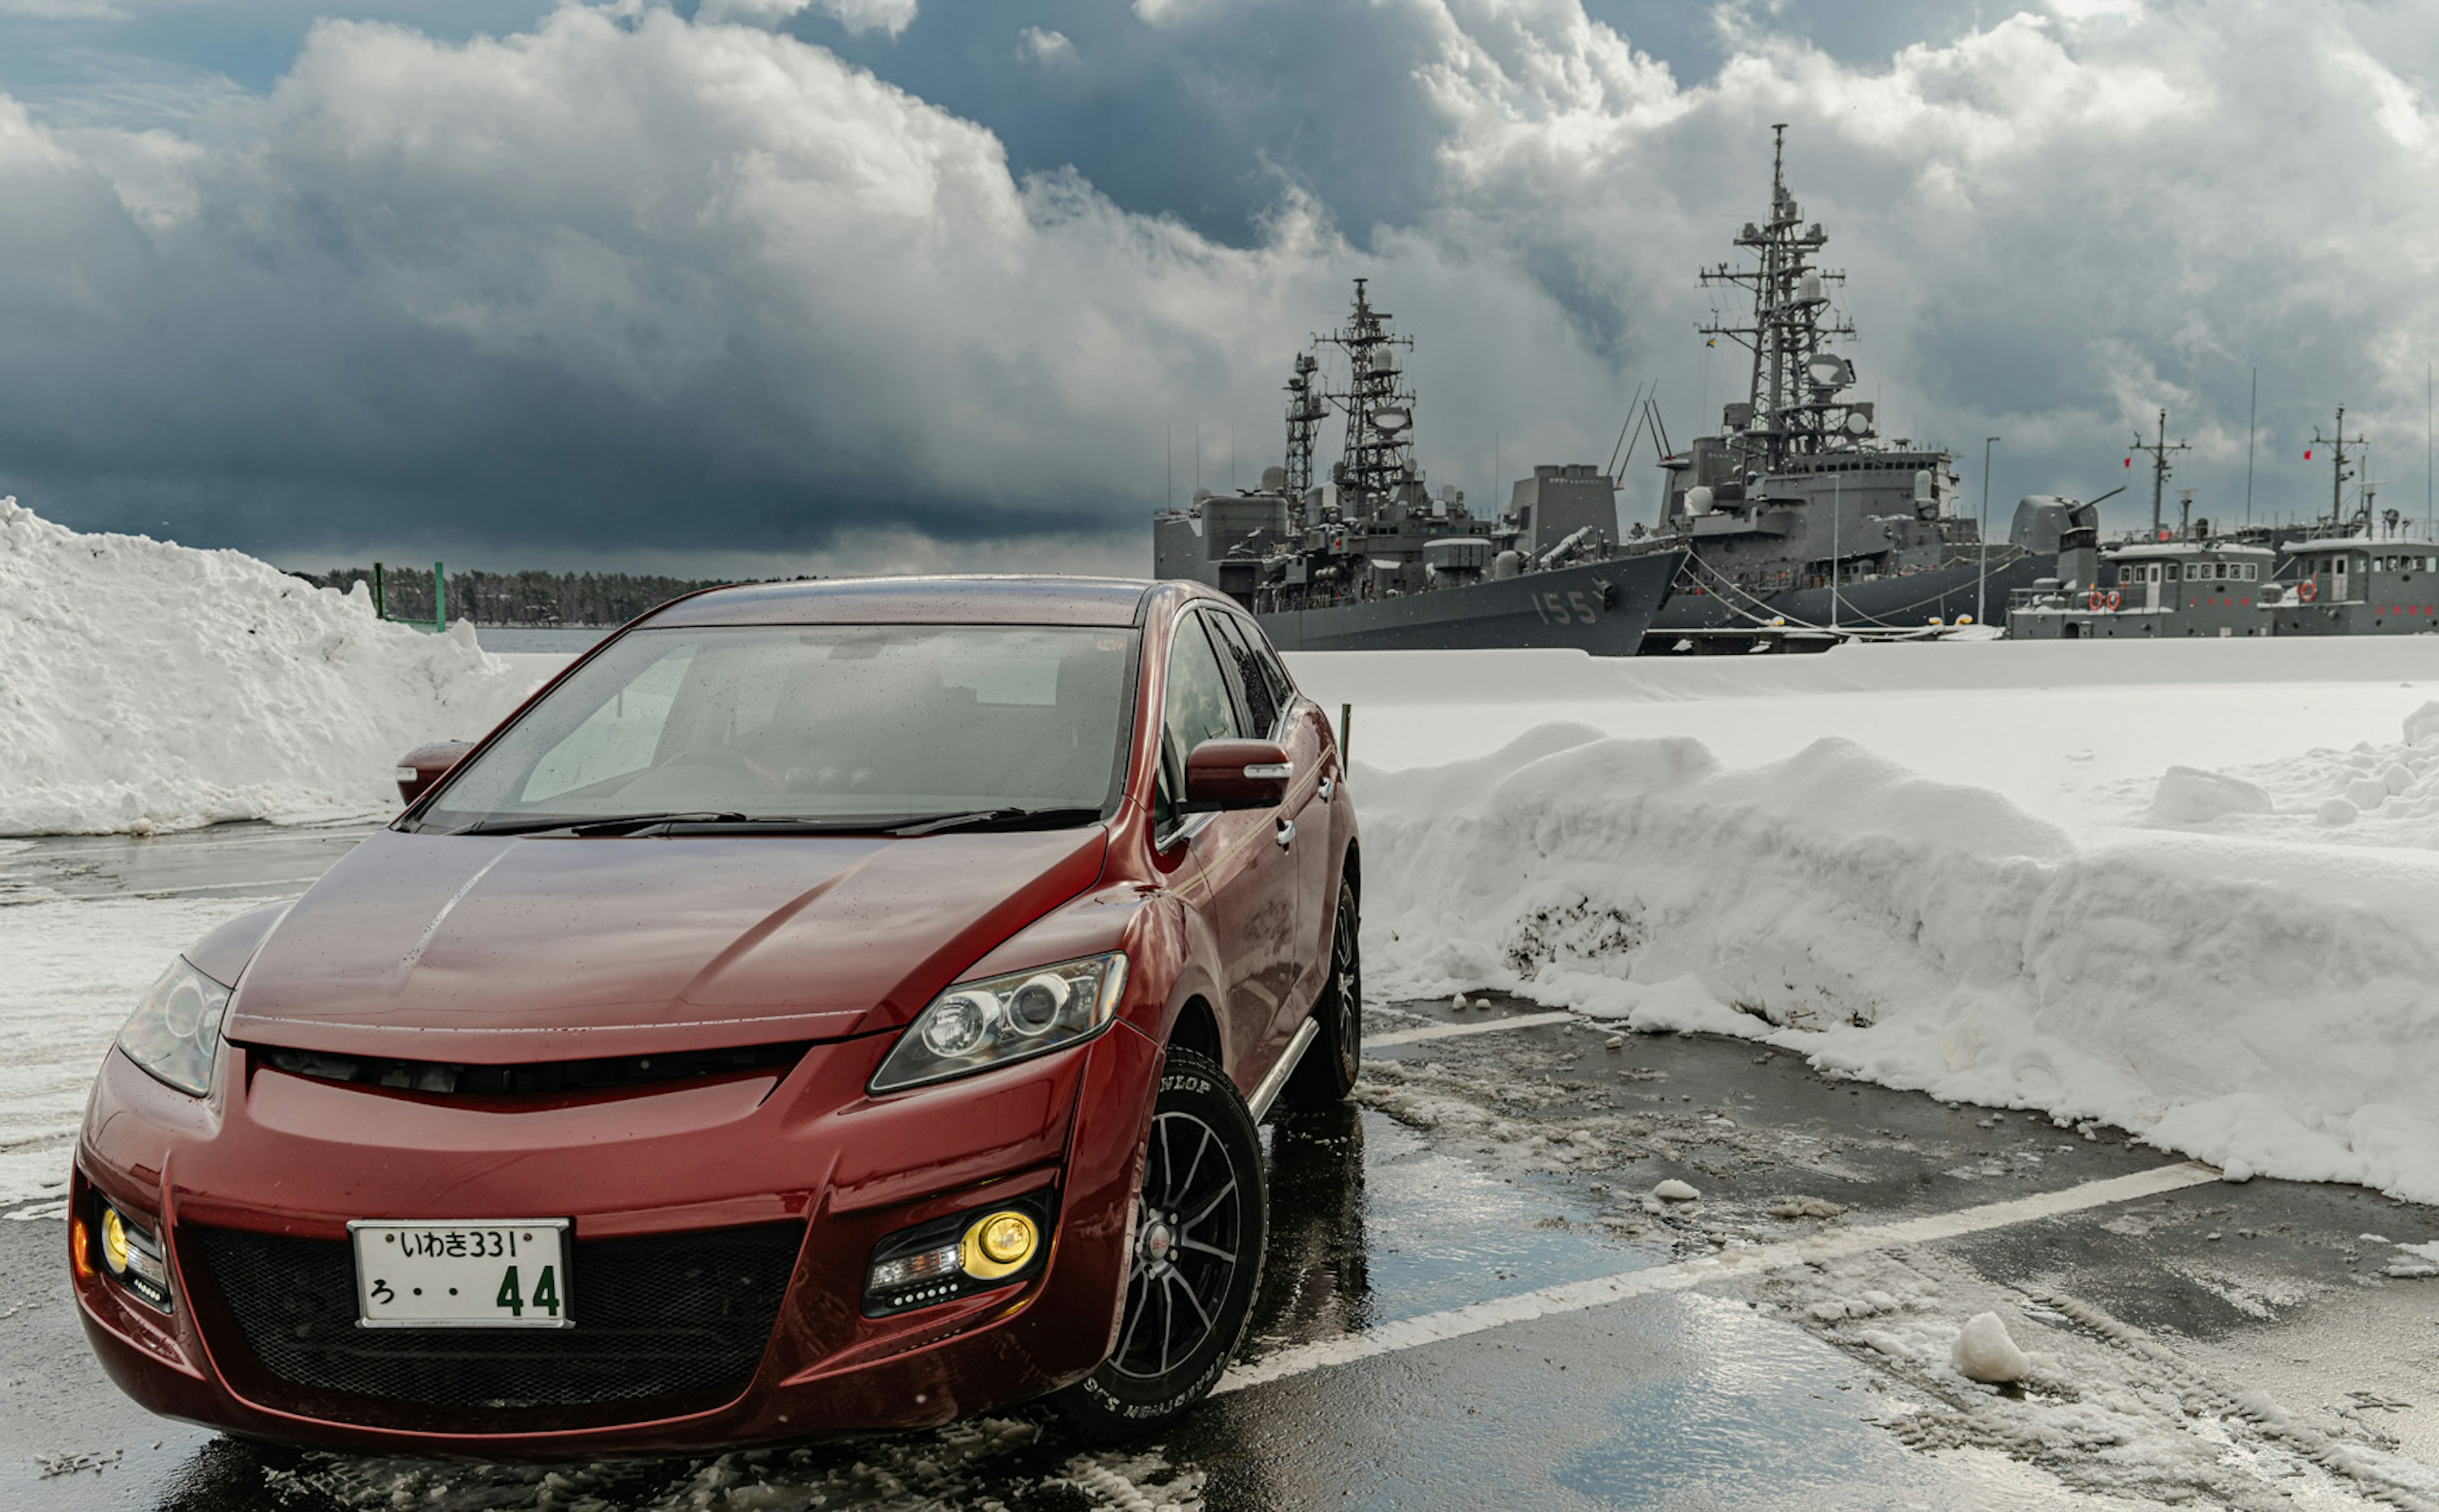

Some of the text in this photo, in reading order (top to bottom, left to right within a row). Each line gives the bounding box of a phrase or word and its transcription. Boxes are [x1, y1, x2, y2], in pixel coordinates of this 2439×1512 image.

[1531, 591, 1596, 625] 155
[1159, 1074, 1212, 1094] NLOP
[496, 1266, 560, 1316] 44
